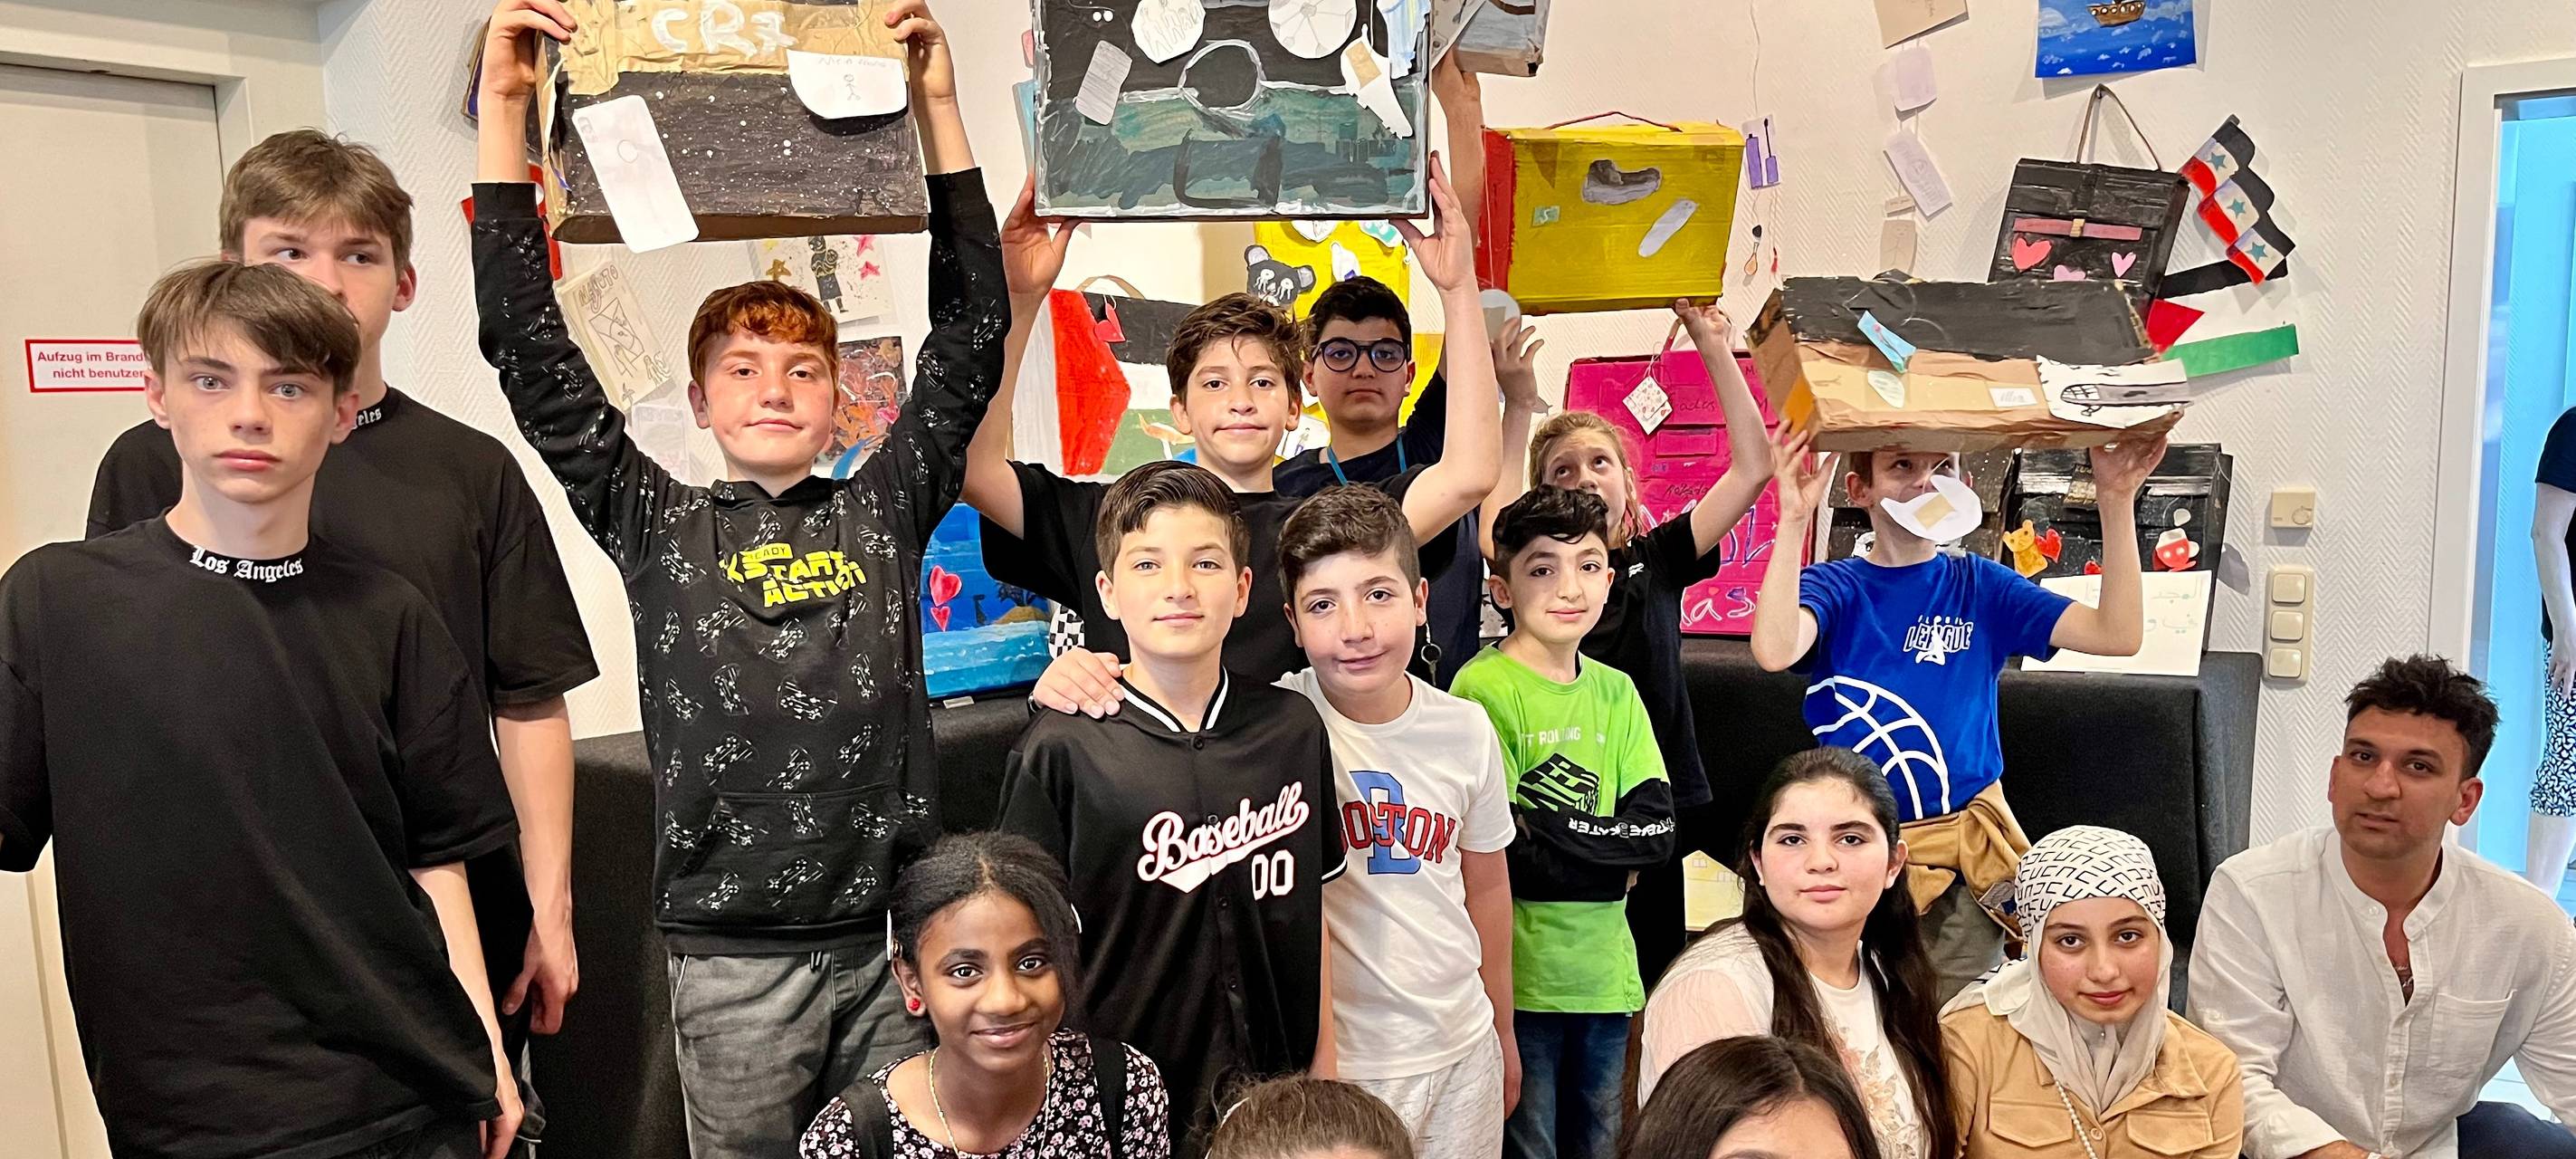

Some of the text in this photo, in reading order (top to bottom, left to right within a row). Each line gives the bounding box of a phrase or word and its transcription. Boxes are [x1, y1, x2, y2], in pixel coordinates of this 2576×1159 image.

[37, 351, 82, 363] Aufzug
[87, 351, 101, 361] im
[52, 368, 85, 378] nicht
[189, 544, 304, 583] Los Angeles
[1903, 621, 1974, 653] LEAGUE
[1137, 781, 1310, 882] Baseball
[1251, 849, 1294, 901] 00
